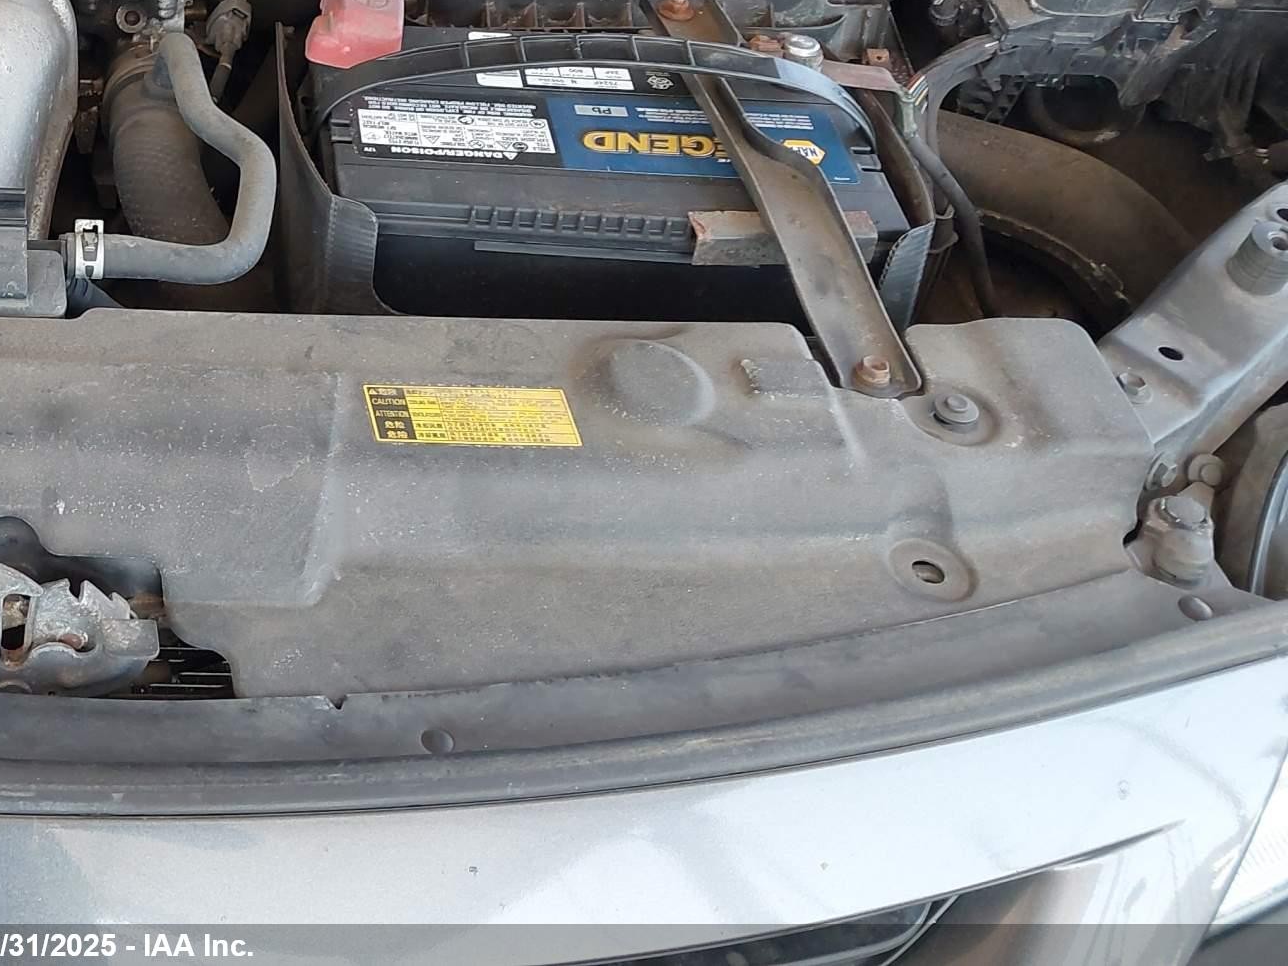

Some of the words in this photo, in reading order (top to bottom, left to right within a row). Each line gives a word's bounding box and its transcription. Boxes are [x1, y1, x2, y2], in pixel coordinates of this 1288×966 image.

[591, 107, 613, 117] Pb
[581, 131, 730, 157] EGEND
[390, 146, 504, 159] DANGER/POISON
[794, 147, 820, 159] NAP
[372, 398, 406, 406] CAUTION
[375, 410, 410, 418] ATTENTION
